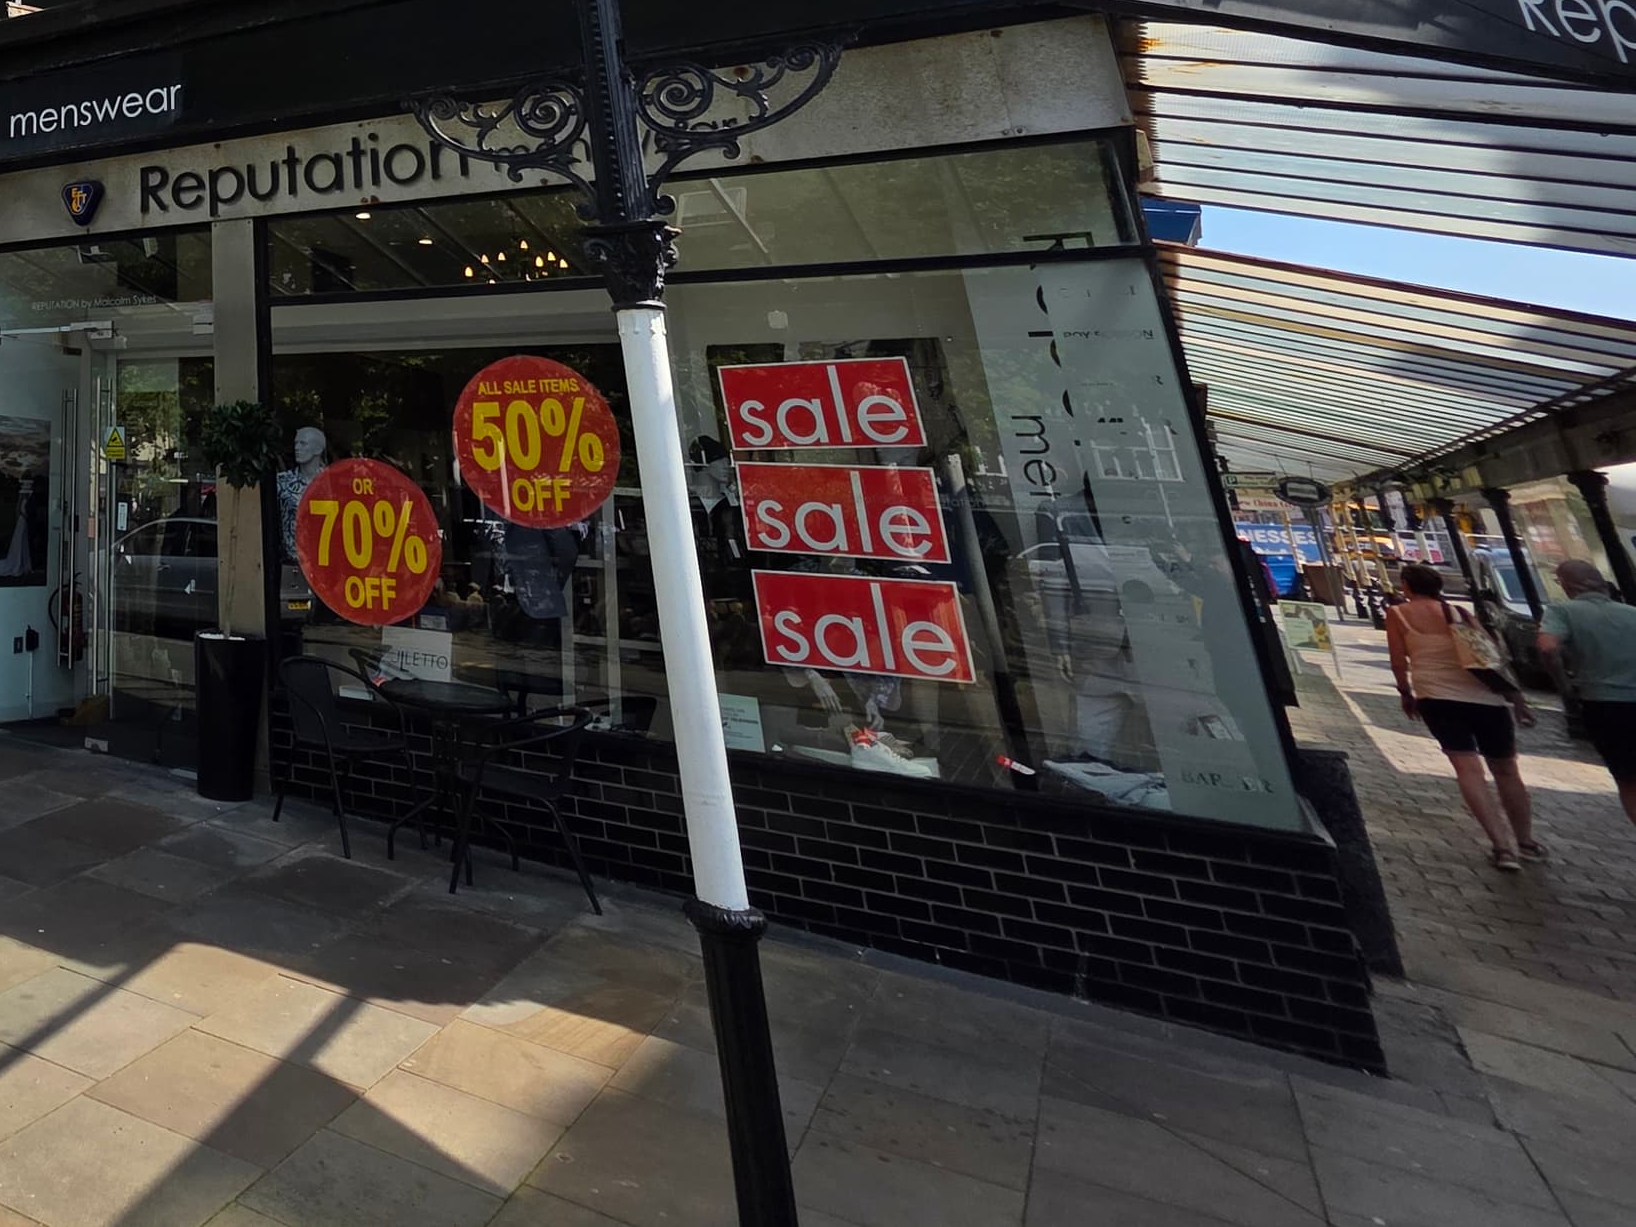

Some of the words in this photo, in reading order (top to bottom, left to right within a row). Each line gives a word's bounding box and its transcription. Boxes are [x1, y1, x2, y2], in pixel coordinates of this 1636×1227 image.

[9, 83, 182, 140] menswear
[139, 133, 470, 217] Reputation
[31, 298, 79, 310] REPUTATION
[81, 299, 91, 310] by
[94, 296, 131, 307] Malcolm
[132, 294, 157, 307] Sykes
[477, 381, 501, 396] ALL
[504, 379, 537, 395] SALE
[539, 377, 580, 394] ITEMS
[739, 364, 909, 446] sale
[471, 396, 604, 473] 50%
[352, 478, 374, 495] OR
[511, 478, 573, 512] OFF
[755, 470, 933, 559] sale
[309, 500, 428, 574] 70%
[344, 576, 397, 610] OFF
[773, 582, 958, 675] sale
